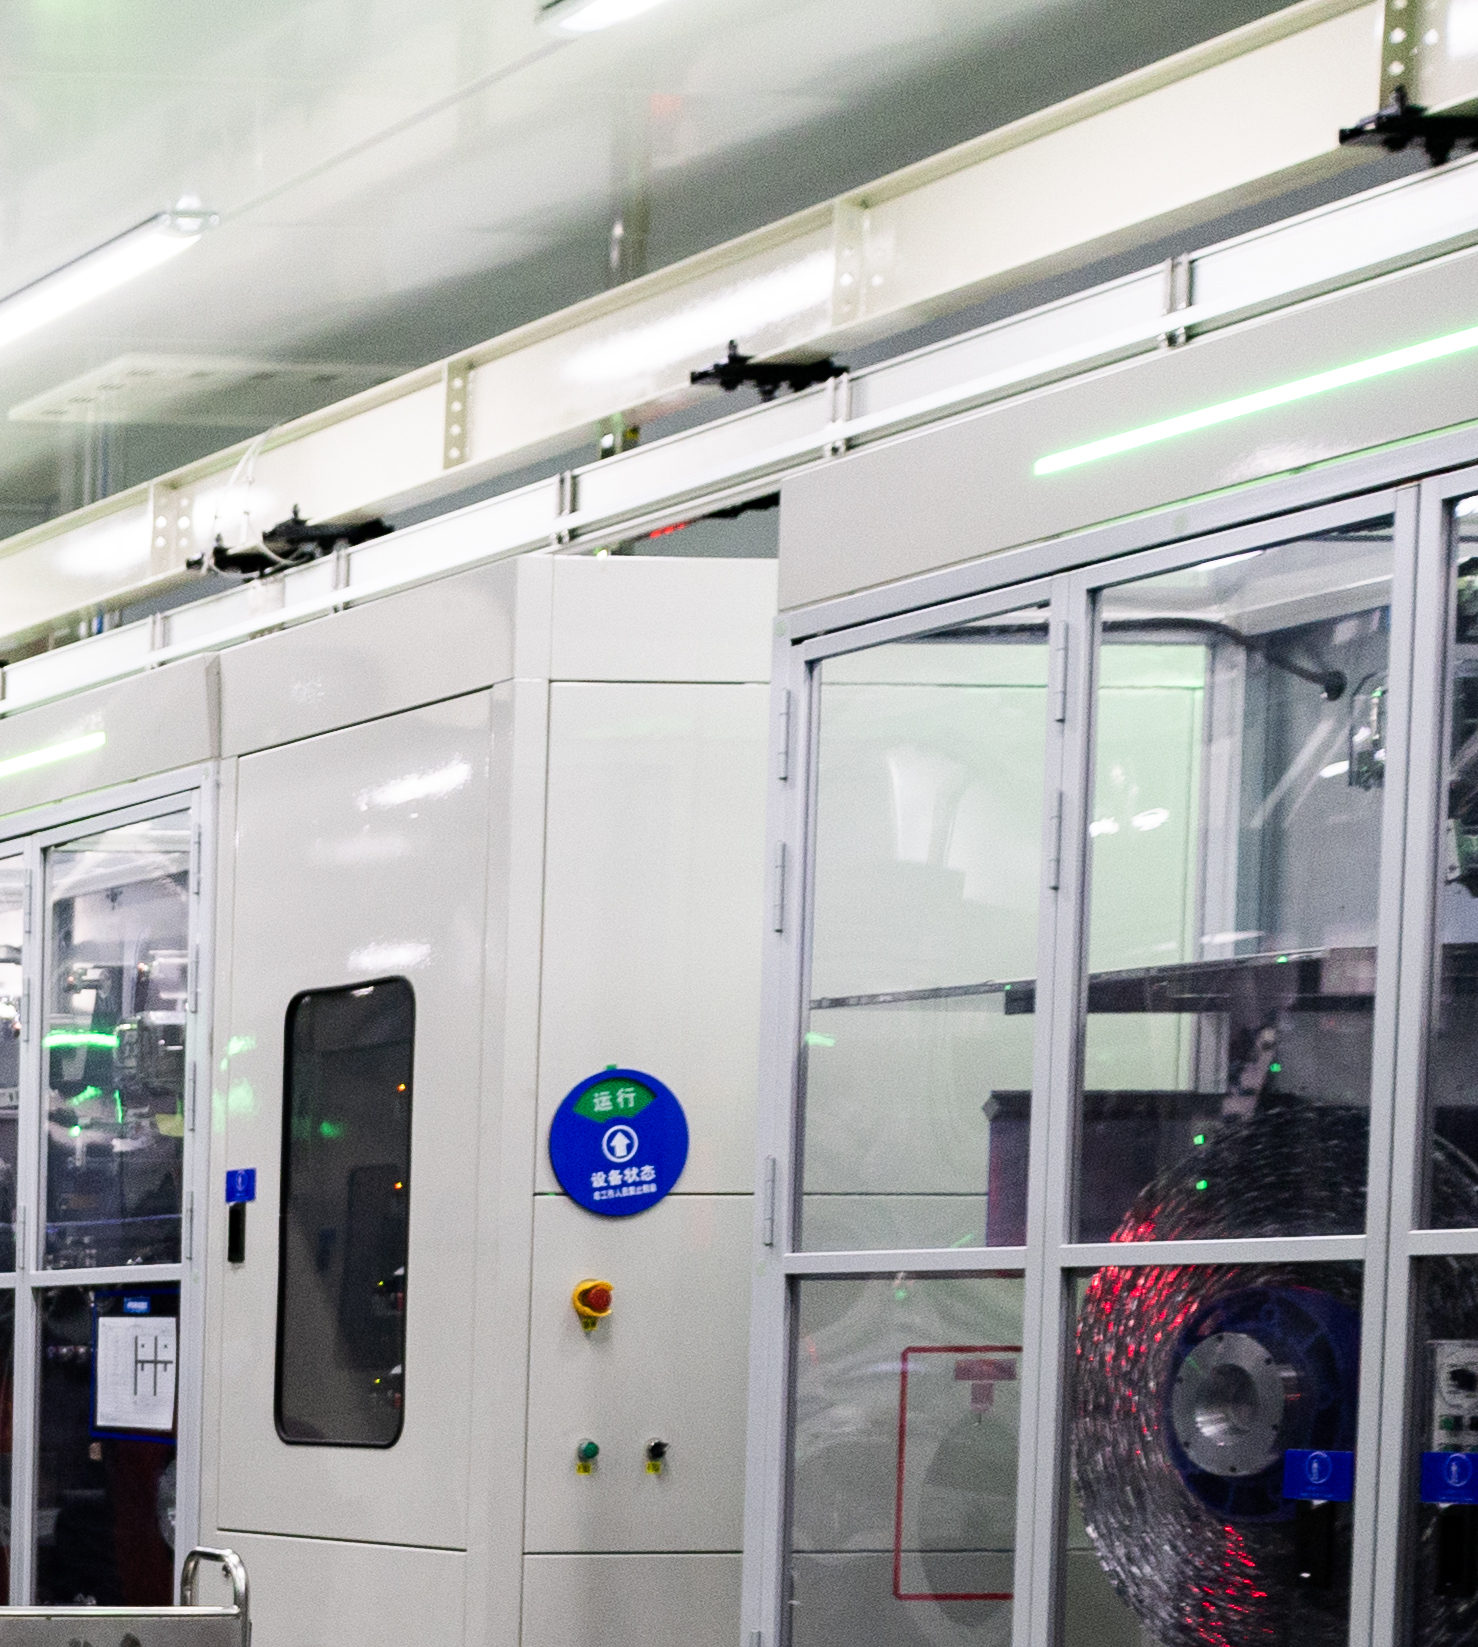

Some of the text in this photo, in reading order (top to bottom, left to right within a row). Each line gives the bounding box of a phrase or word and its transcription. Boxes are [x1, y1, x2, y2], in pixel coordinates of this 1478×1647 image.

[592, 1087, 636, 1112] 运行
[590, 1164, 656, 1189] 设备状态
